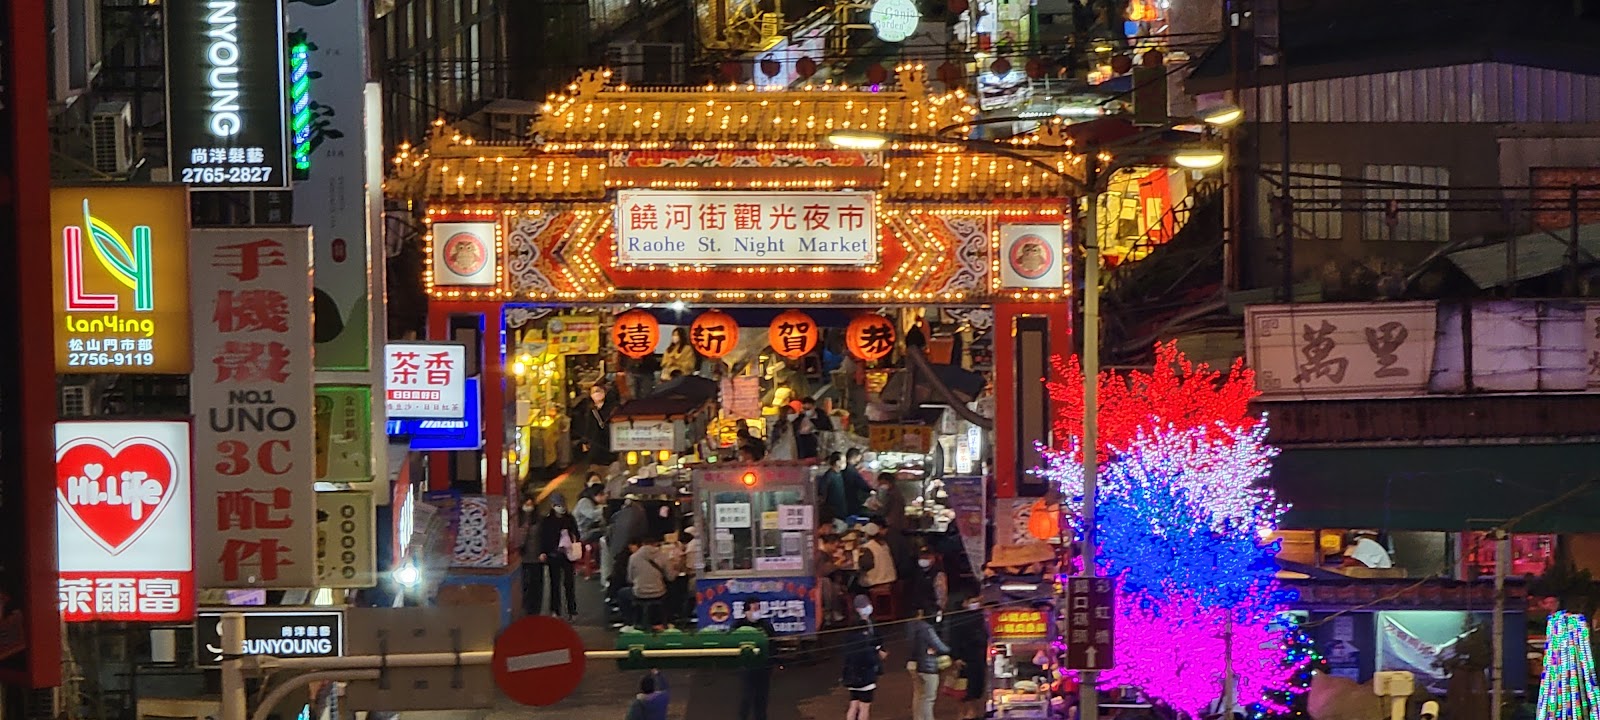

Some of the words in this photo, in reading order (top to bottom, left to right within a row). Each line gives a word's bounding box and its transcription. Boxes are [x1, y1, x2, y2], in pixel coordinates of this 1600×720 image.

[191, 148, 264, 164] 尚洋髮藝
[182, 167, 273, 183] 2765-2827
[630, 203, 865, 231] 饒河街觀光夜市
[628, 236, 685, 252] Raohe
[698, 236, 721, 252] St.
[734, 236, 785, 257] Night
[798, 236, 868, 252] Market
[68, 338, 154, 351] 松山門市部
[778, 322, 808, 353] 賀
[68, 353, 154, 366] 2756-9119
[391, 351, 454, 386] 茶香
[209, 407, 297, 432] UNO
[215, 440, 293, 475] 3C
[67, 463, 163, 520] Hi-Life
[217, 487, 295, 581] 配件
[59, 578, 181, 613] 萊爾富
